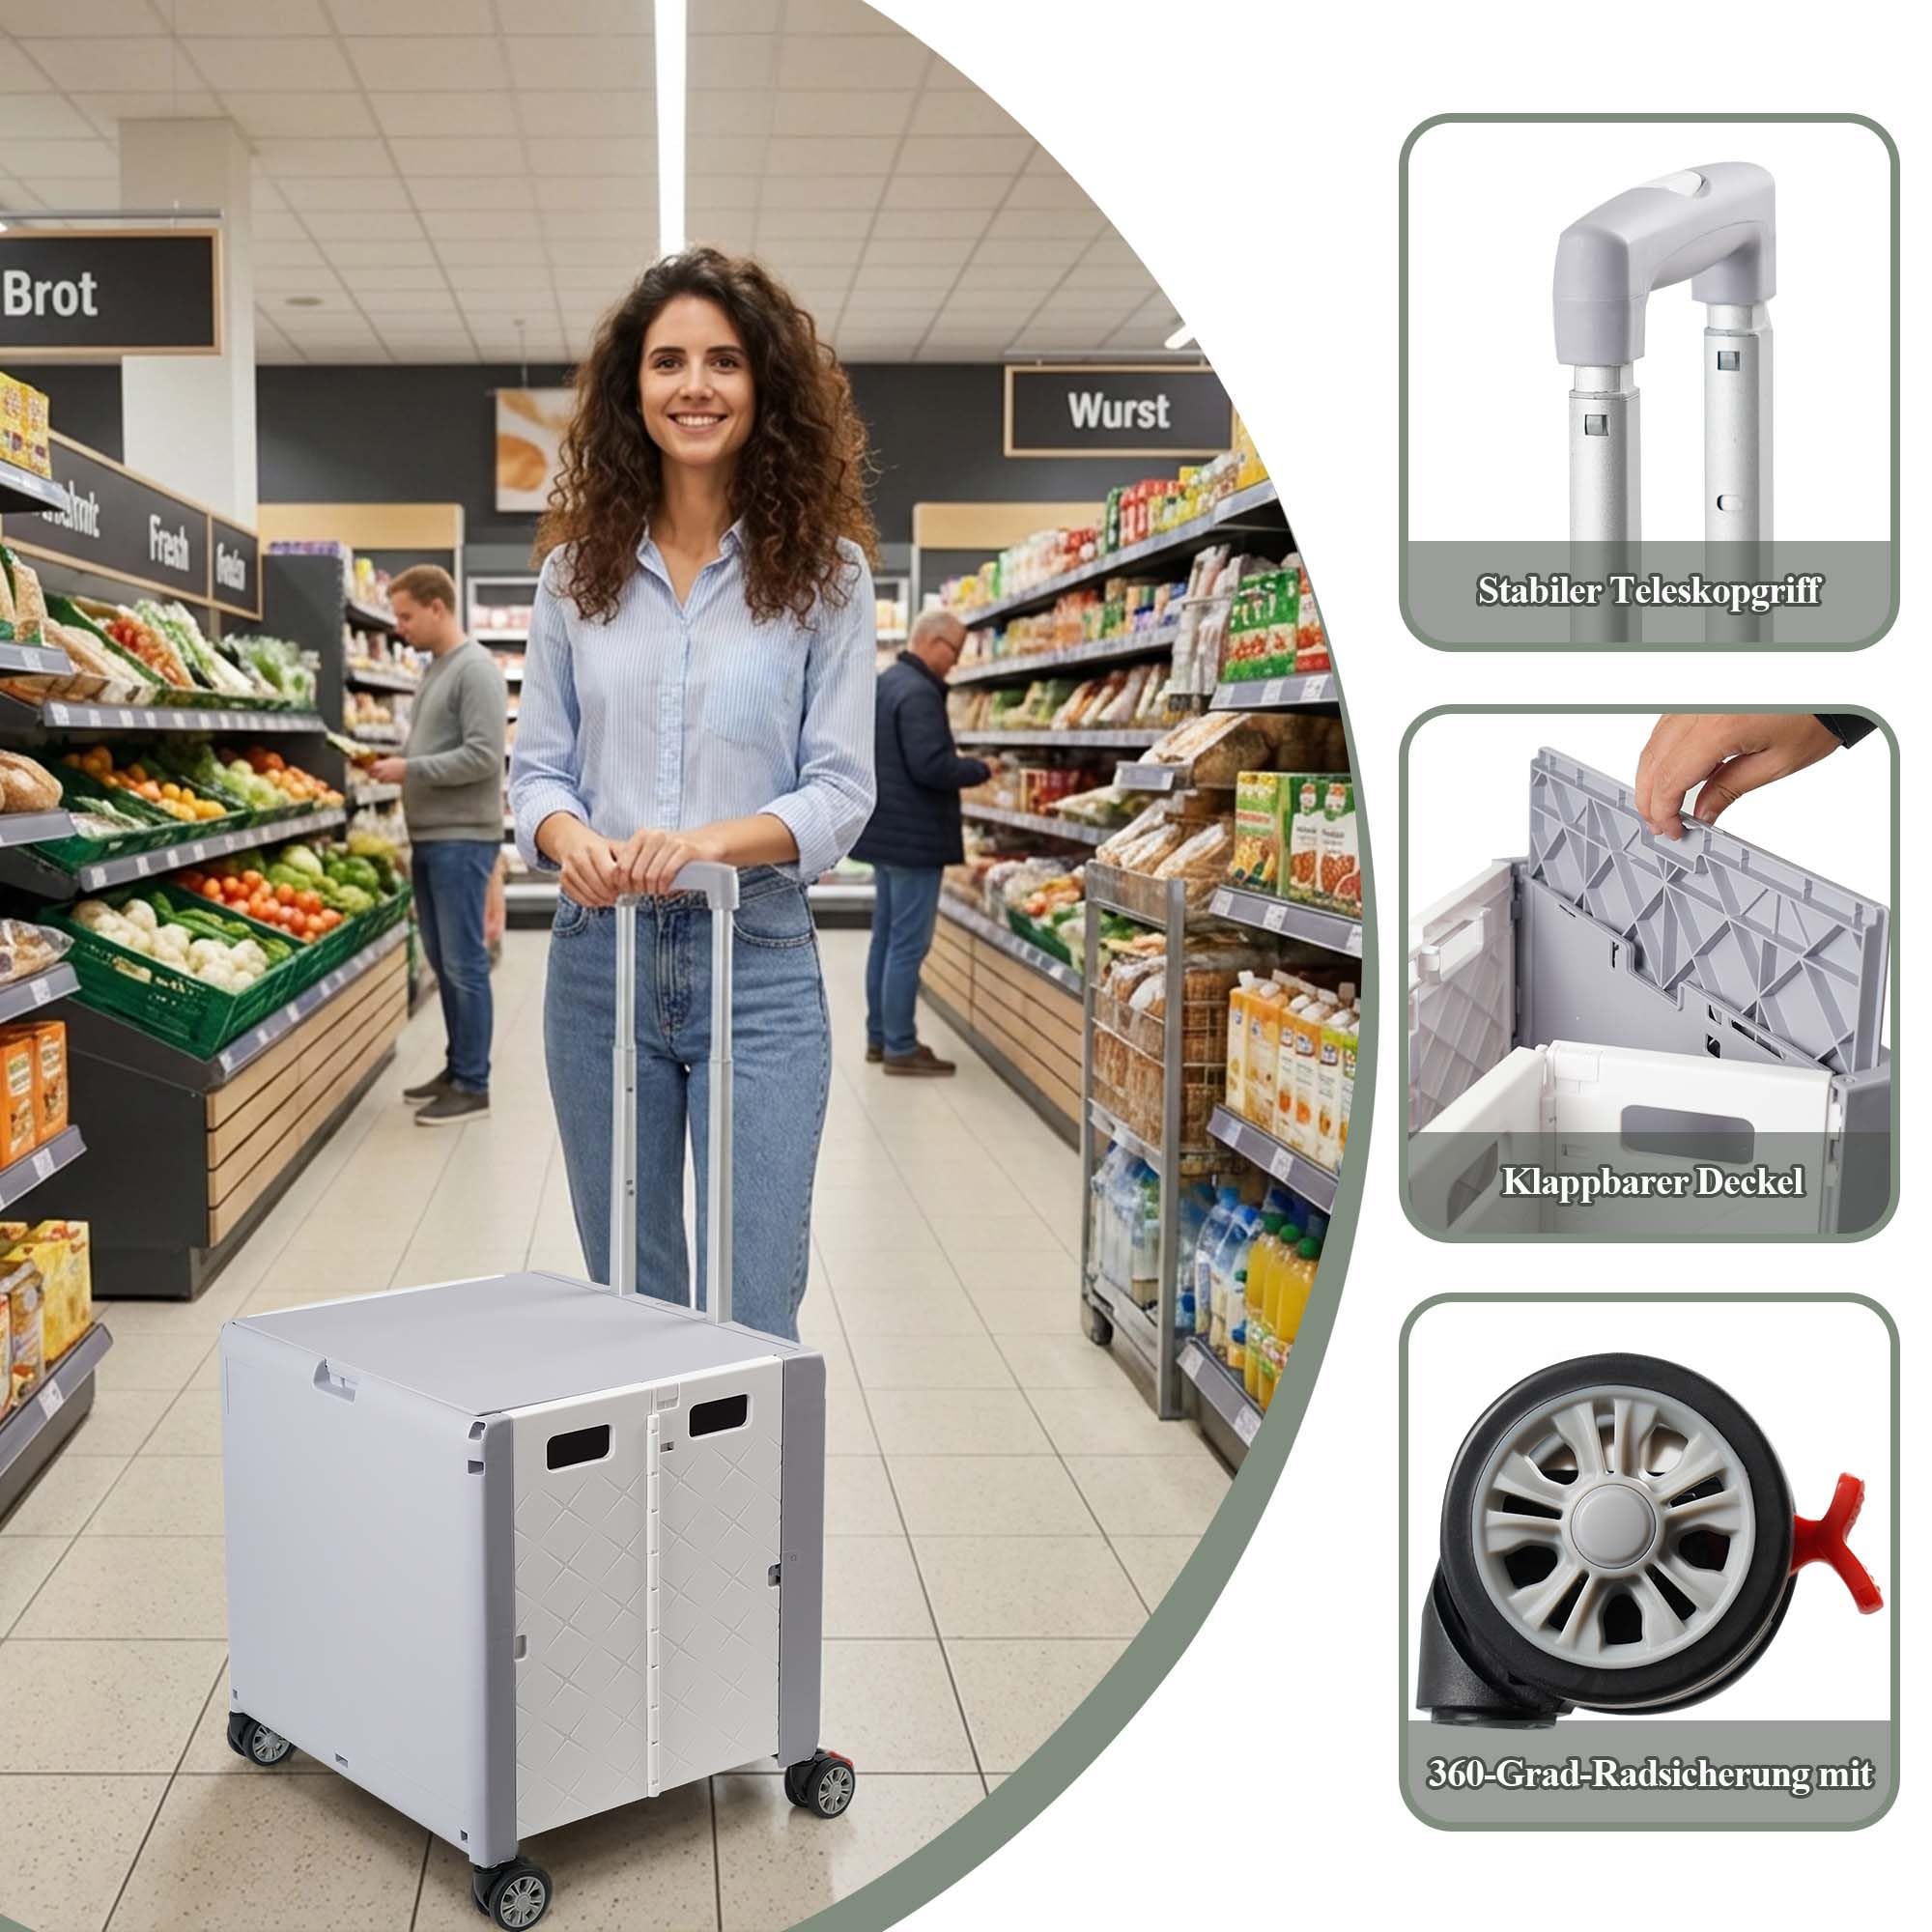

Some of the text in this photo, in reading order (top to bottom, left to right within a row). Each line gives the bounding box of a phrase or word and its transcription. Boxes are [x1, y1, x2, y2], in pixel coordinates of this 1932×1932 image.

[3, 270, 99, 317] Brot
[1067, 391, 1171, 429] Wurst
[149, 513, 189, 572] Fresh
